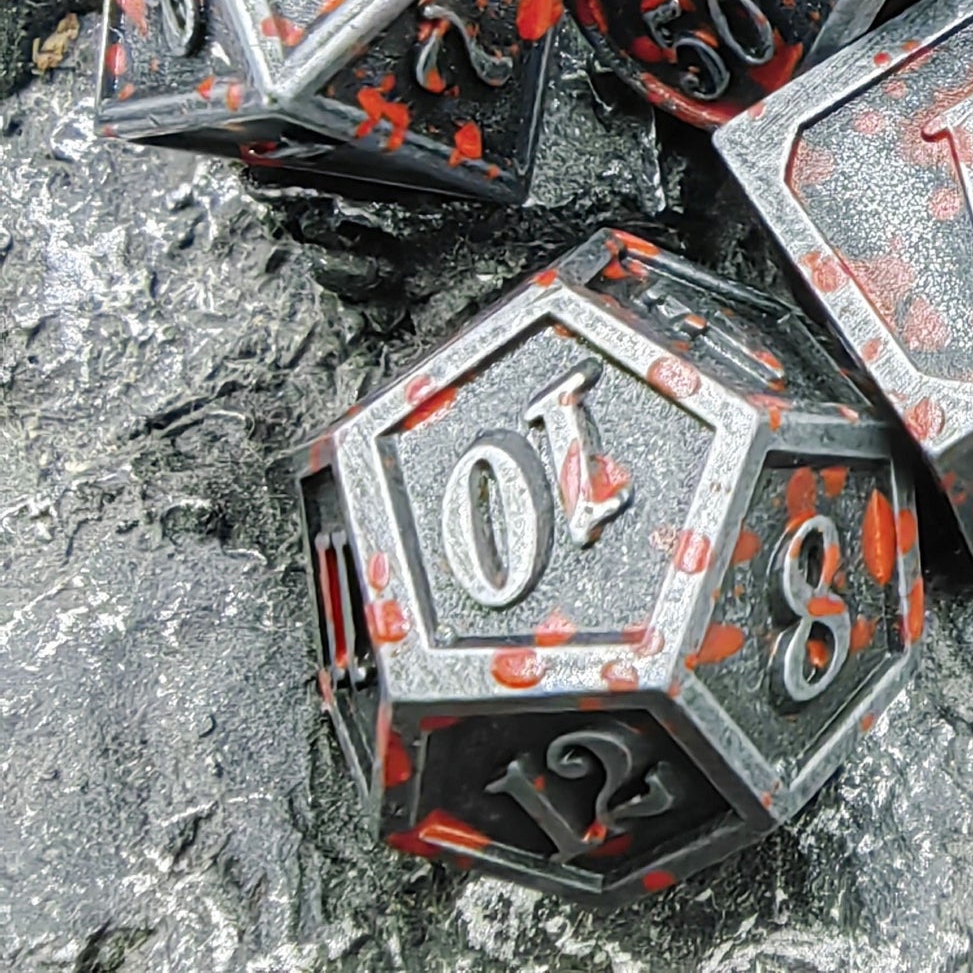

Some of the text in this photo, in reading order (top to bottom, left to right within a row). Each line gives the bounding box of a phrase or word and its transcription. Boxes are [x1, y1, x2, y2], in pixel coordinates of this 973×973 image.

[442, 367, 631, 606] 10
[780, 513, 850, 702] 8
[484, 729, 674, 864] 12
